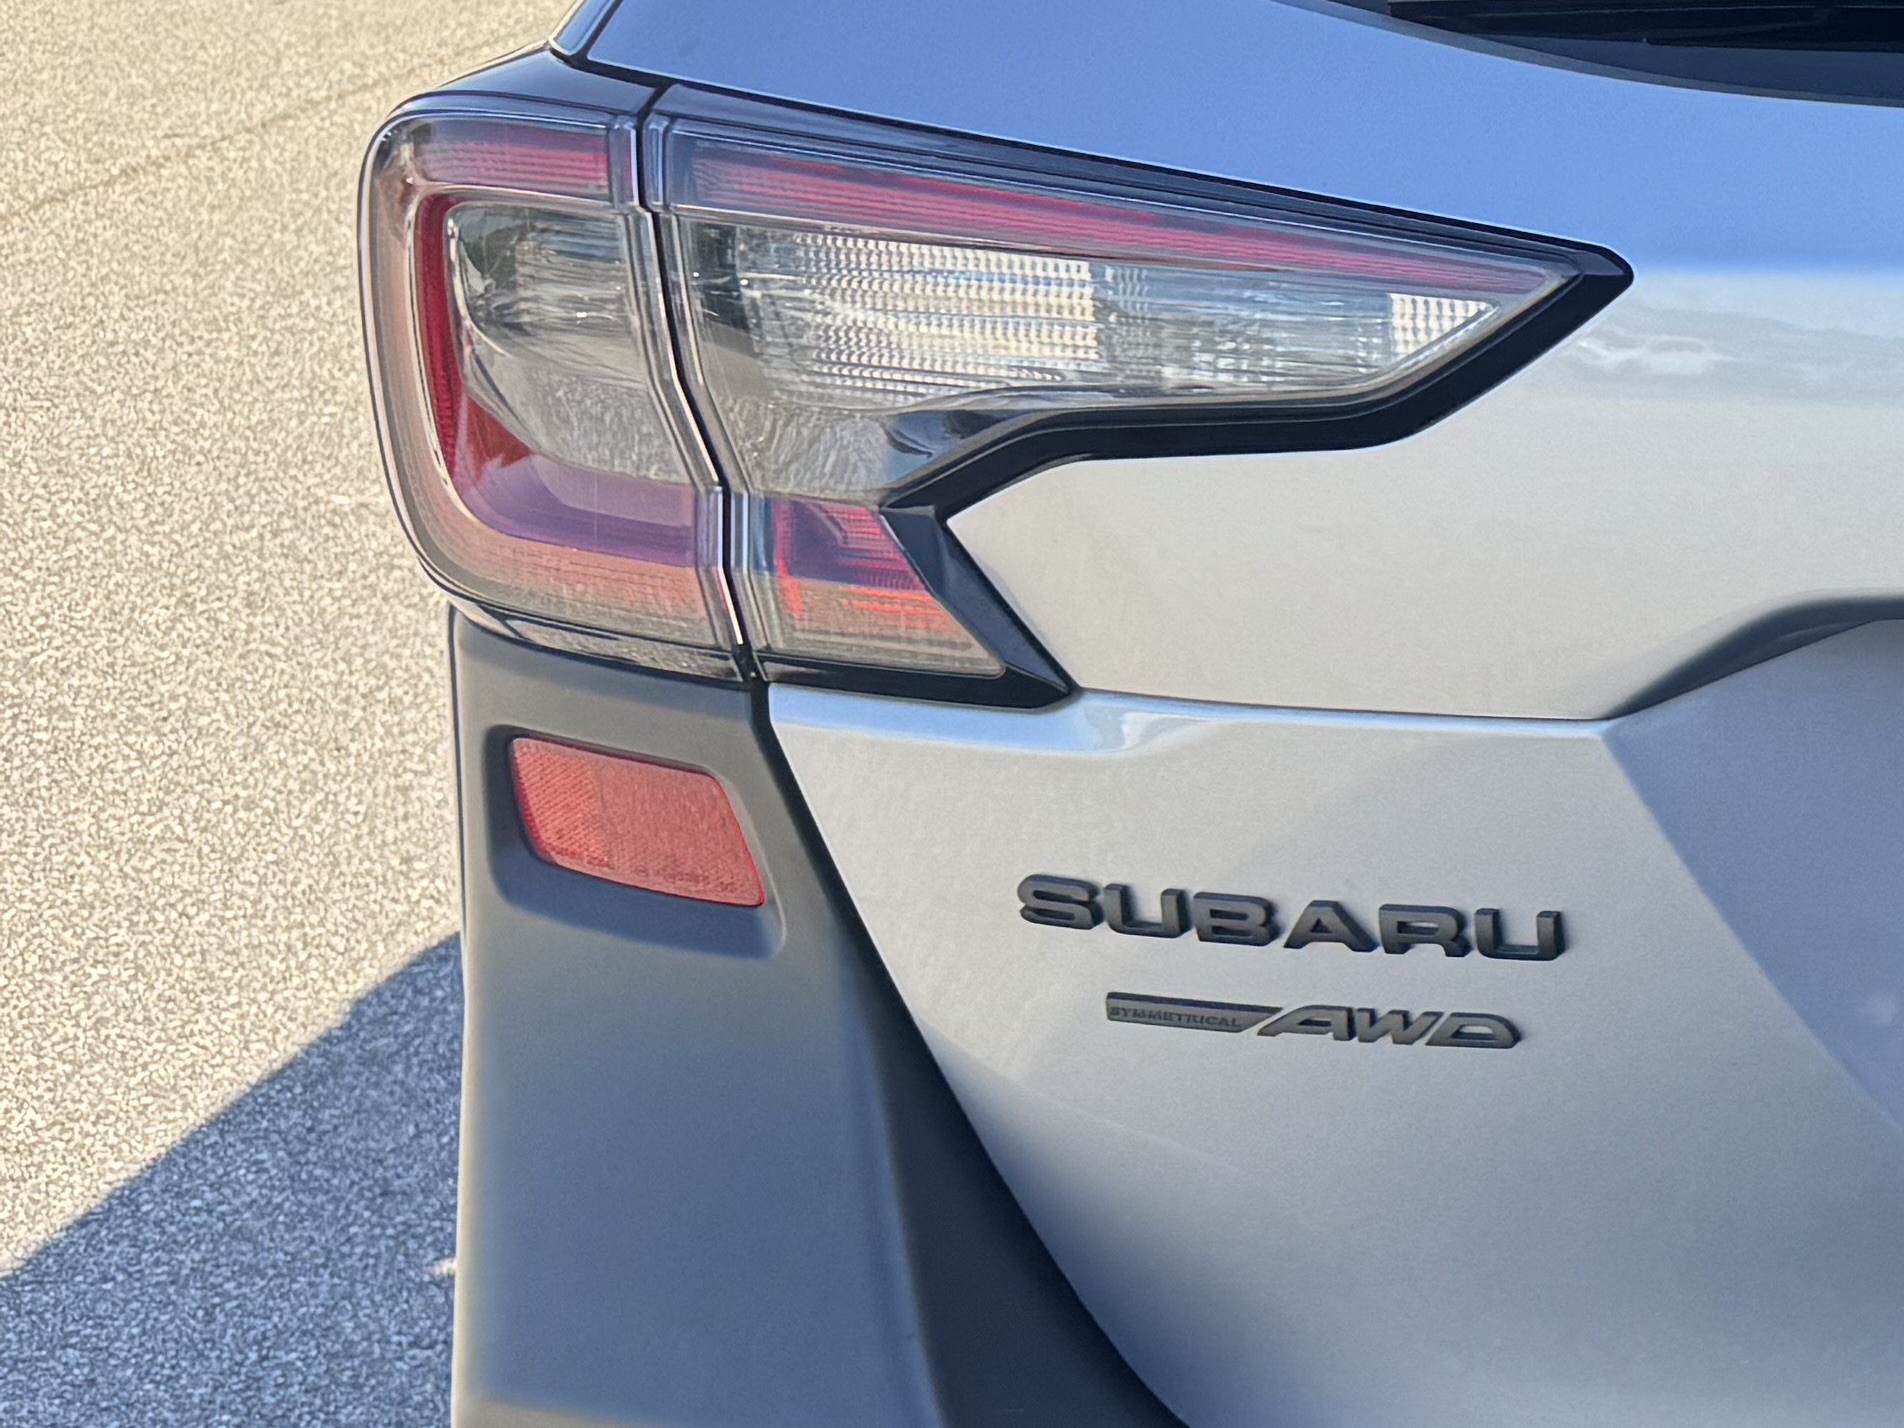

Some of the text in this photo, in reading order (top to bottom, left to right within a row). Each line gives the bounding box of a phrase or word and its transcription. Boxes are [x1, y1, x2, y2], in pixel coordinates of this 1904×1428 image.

[1017, 873, 1566, 961] SUBARU
[1109, 1005, 1521, 1049] SYMMETRICAL AWD
